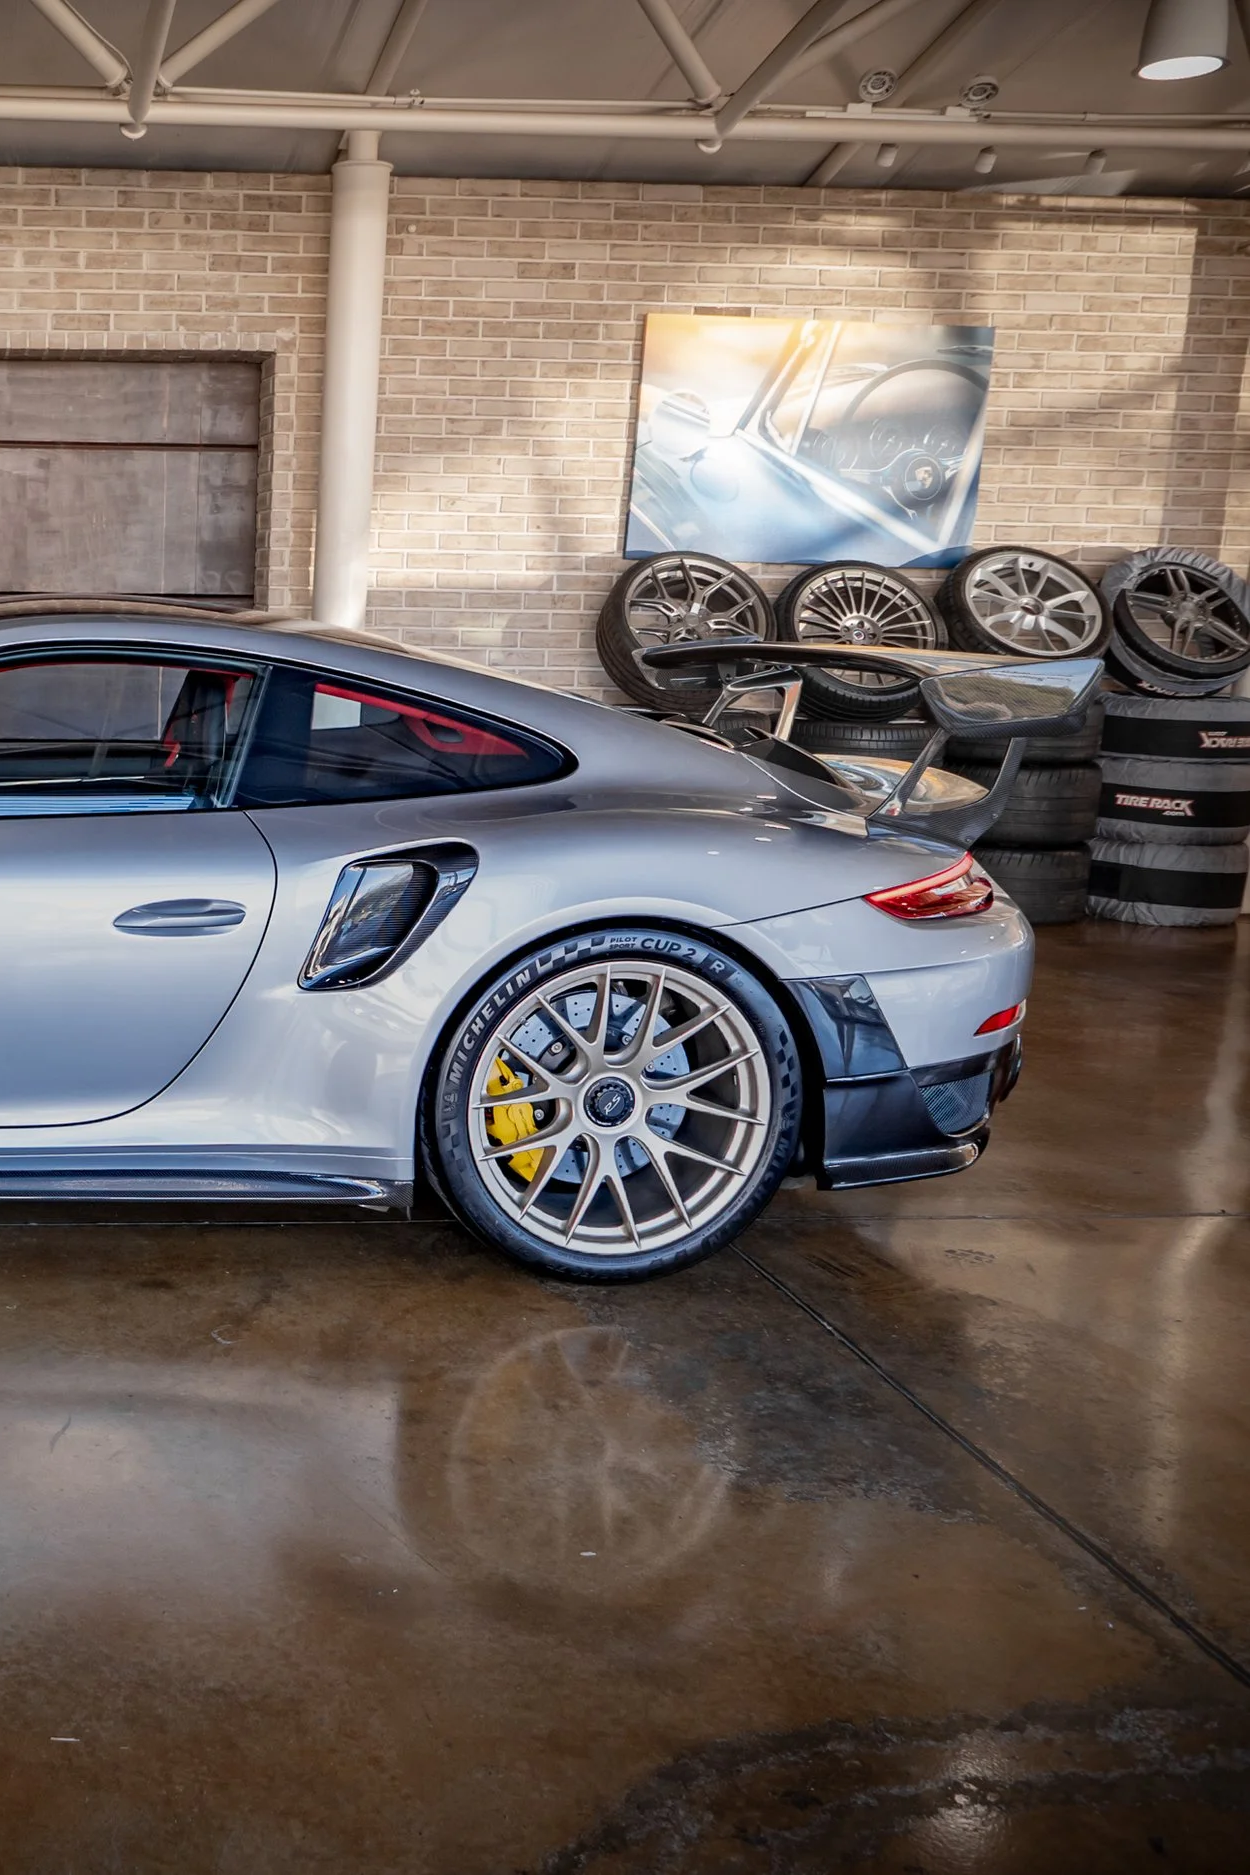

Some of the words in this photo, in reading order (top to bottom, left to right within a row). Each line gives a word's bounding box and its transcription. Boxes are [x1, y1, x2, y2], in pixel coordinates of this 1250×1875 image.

[640, 938, 682, 953] CUP
[682, 947, 696, 959] 2
[709, 960, 725, 974] R
[449, 968, 531, 1086] MICHELIN
[604, 1093, 620, 1115] RS
